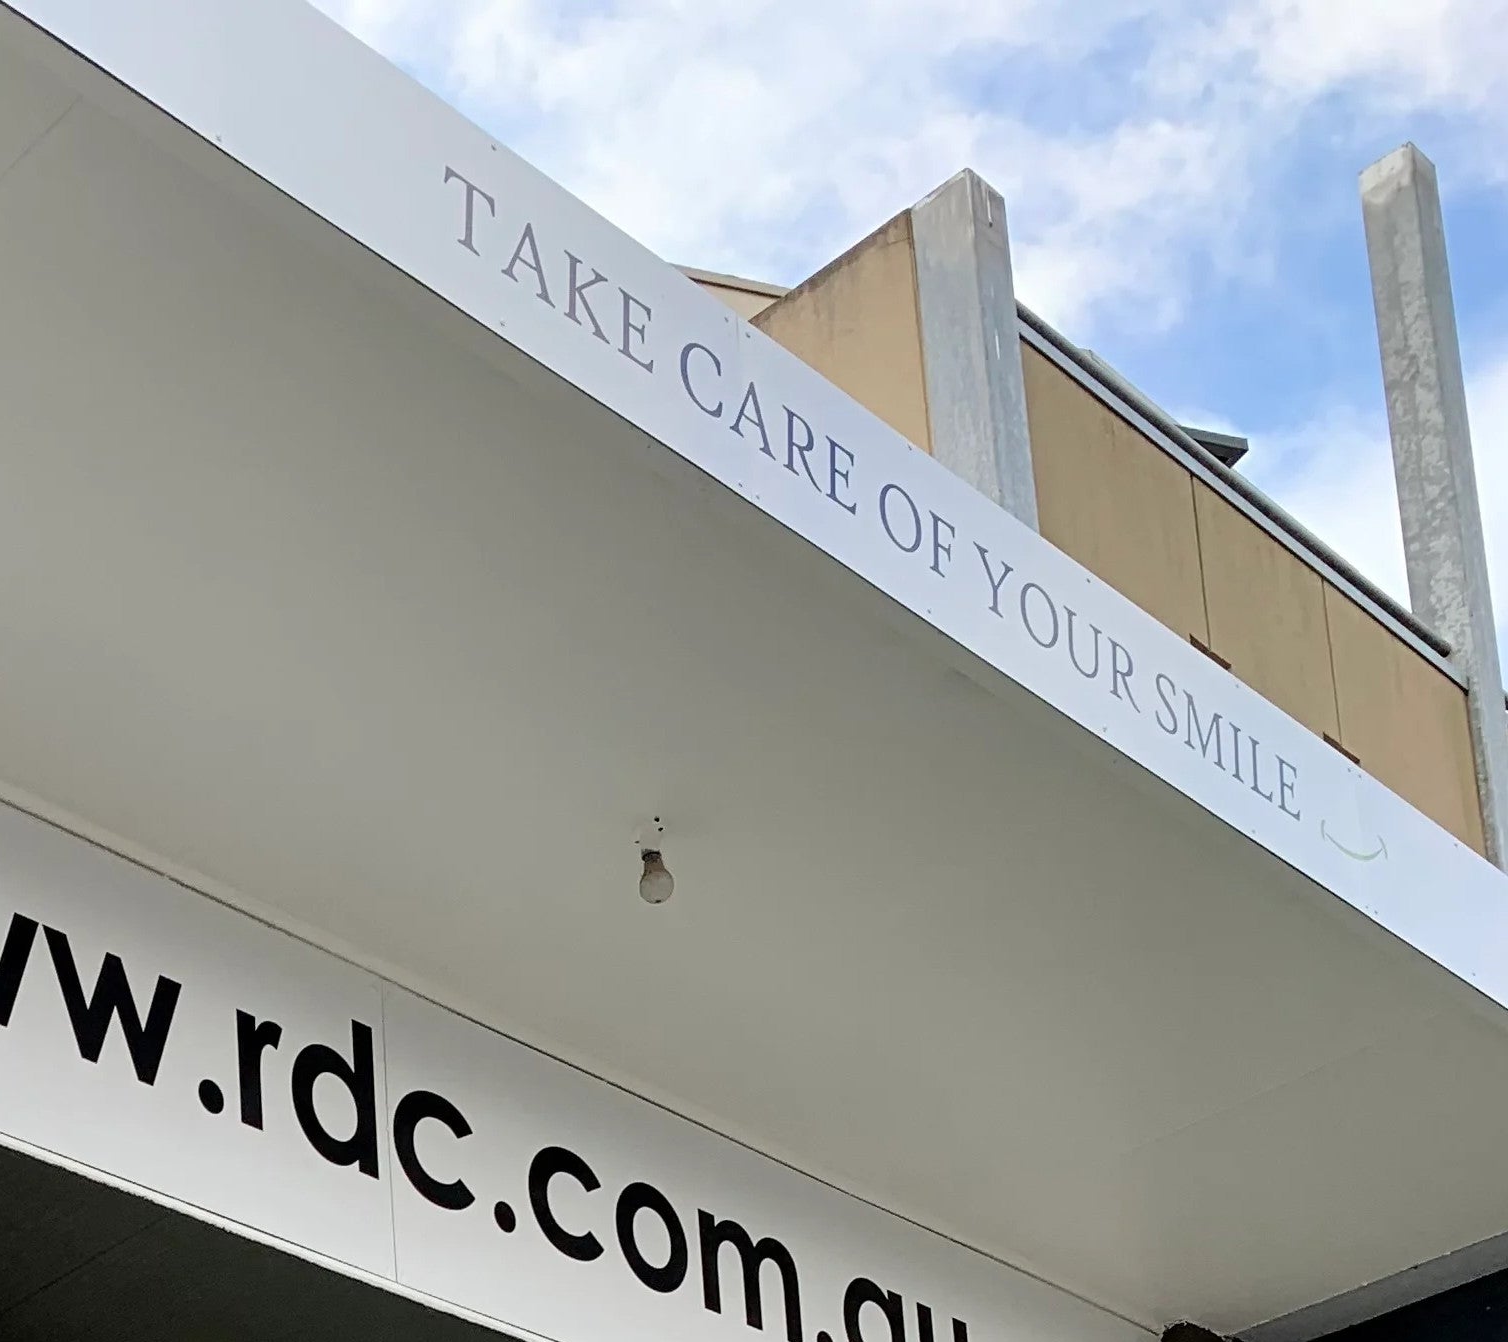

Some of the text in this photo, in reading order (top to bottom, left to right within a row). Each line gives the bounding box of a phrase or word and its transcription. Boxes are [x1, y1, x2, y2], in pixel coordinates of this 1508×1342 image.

[443, 165, 1302, 821] TAKE CARE OF YOUR SMILE
